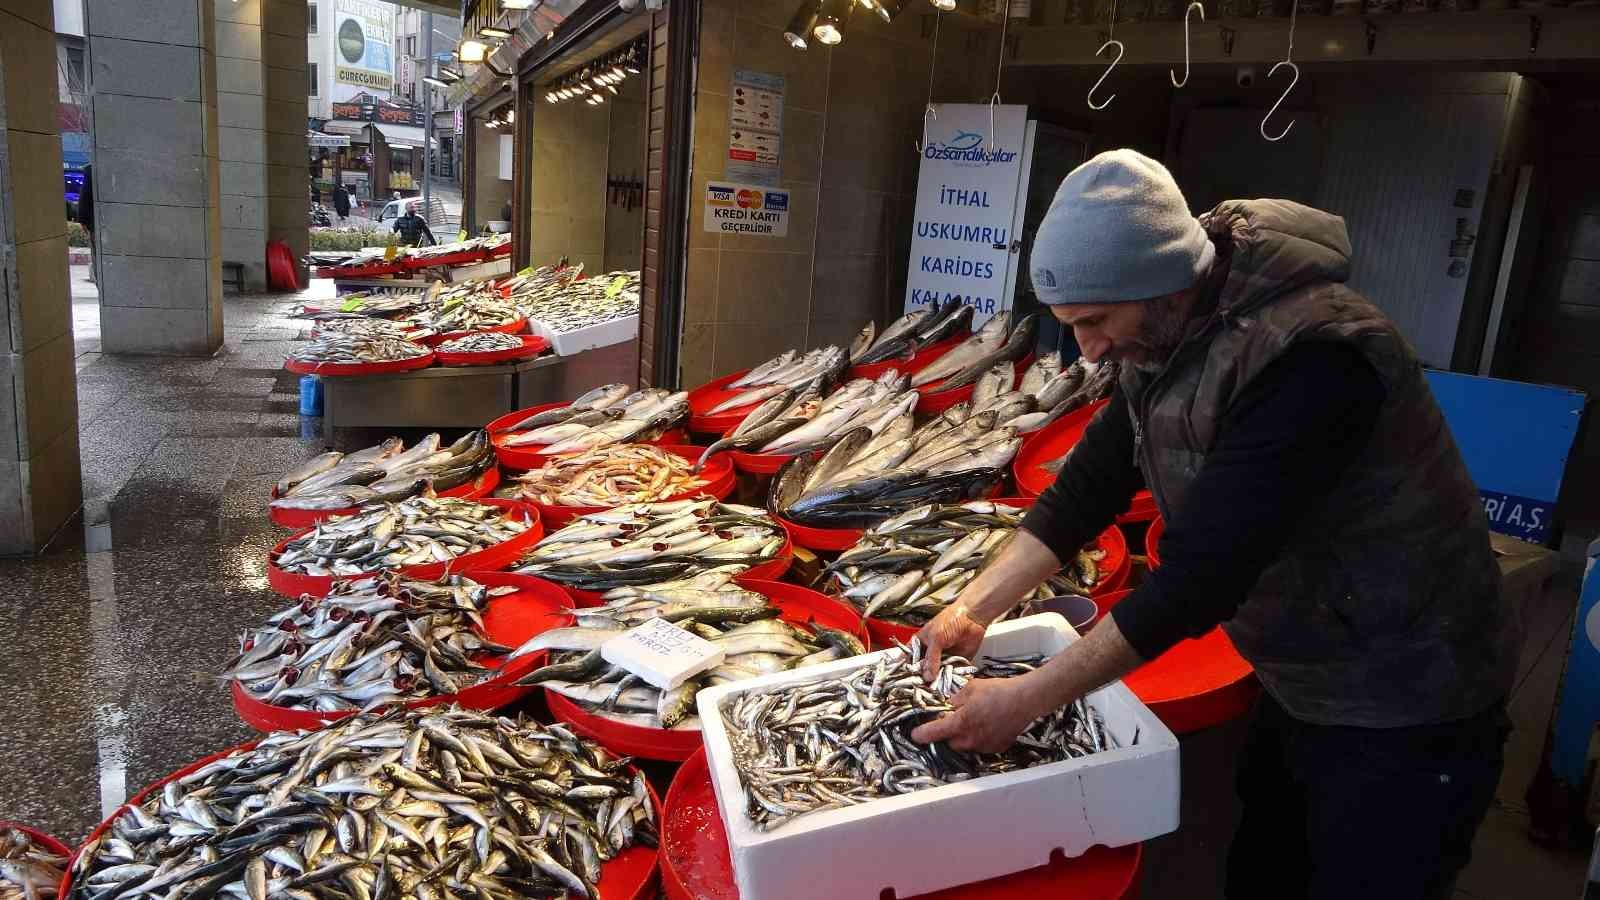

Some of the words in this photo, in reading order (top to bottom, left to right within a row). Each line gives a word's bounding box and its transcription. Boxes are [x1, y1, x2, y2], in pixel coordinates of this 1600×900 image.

[713, 191, 731, 201] VISA
[940, 184, 990, 208] İTHAL
[721, 222, 773, 234] GEÇERLİDİR
[917, 221, 1006, 245] USKUMRU
[921, 255, 993, 279] KARİDES
[1507, 504, 1543, 532] A.Ş.
